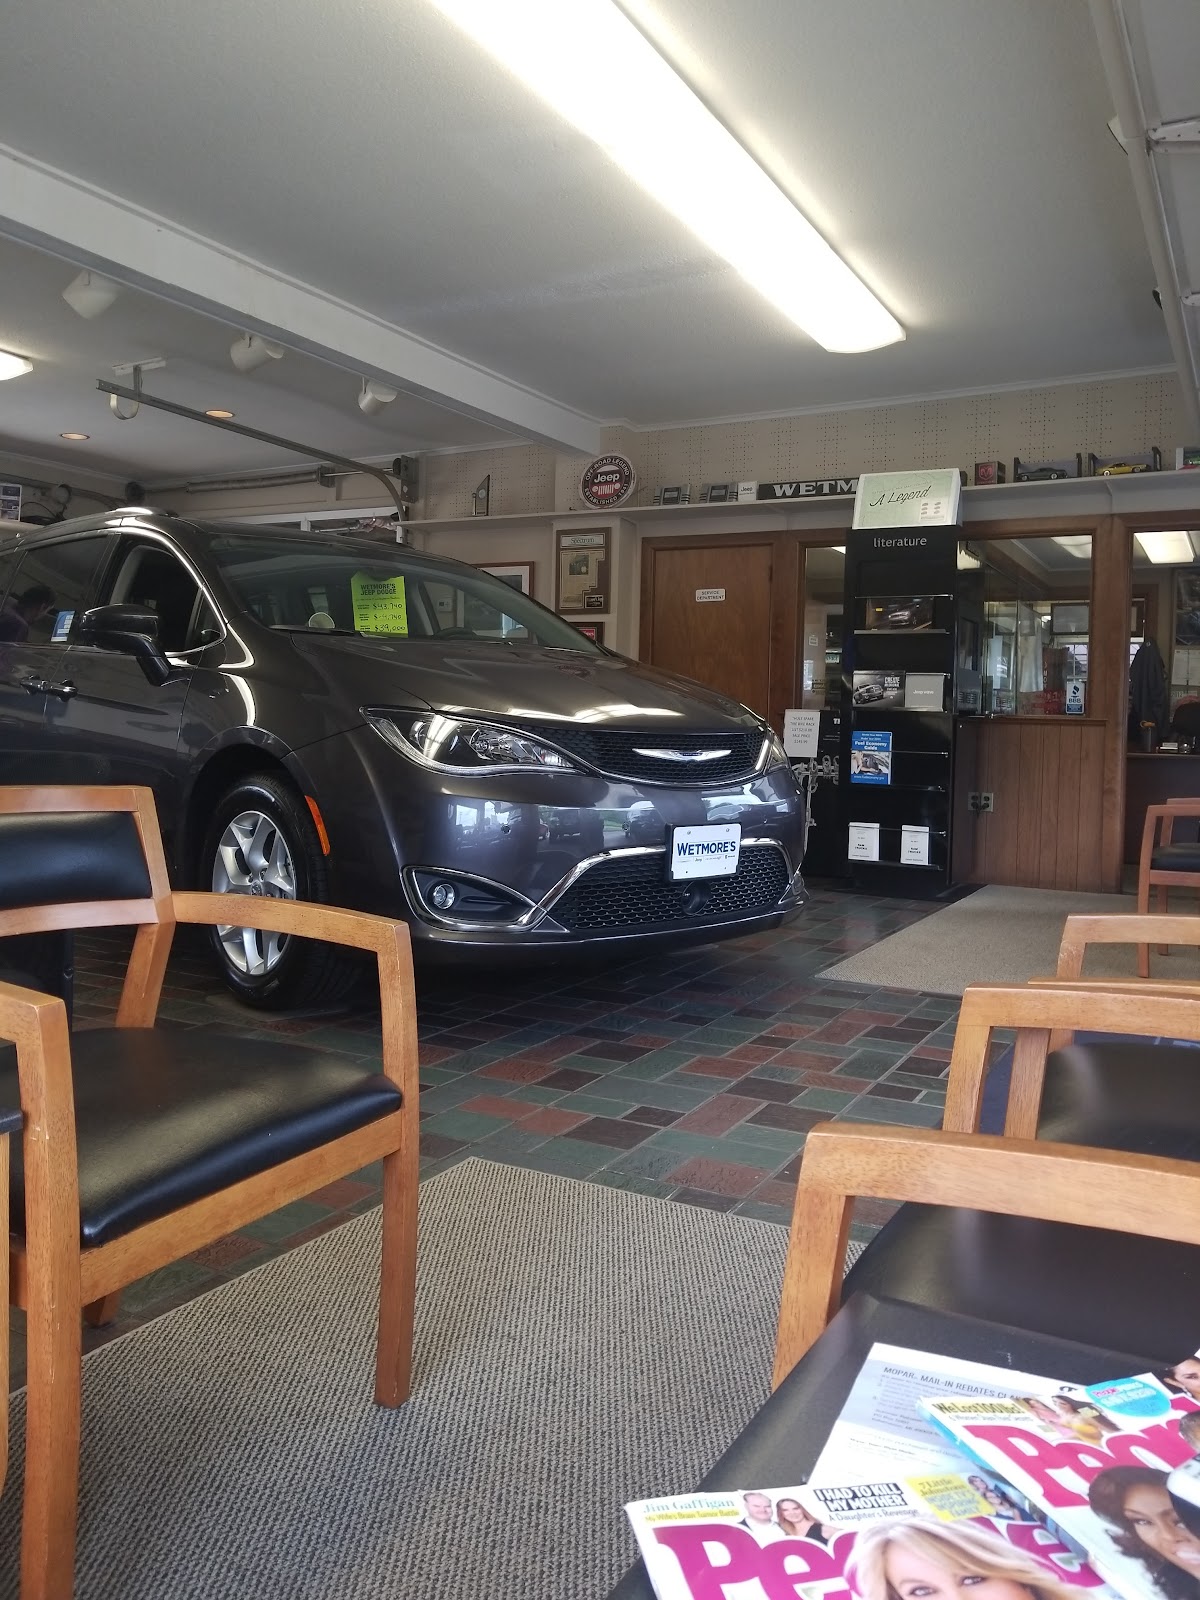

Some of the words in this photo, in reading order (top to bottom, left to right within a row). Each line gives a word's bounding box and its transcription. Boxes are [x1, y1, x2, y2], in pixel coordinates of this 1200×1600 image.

[612, 458, 630, 476] LEGEND
[594, 473, 620, 483] Jeep
[585, 488, 618, 505] ESTABLISHED
[869, 493, 886, 507] A
[887, 485, 931, 504] Legend
[873, 537, 928, 548] literature
[677, 841, 736, 856] WETMORE'S
[920, 1374, 954, 1388] MAIL-IN
[955, 1382, 995, 1397] REBATES
[822, 1488, 853, 1500] HAD
[850, 1485, 872, 1497] TO
[869, 1483, 902, 1496] KILL
[643, 1504, 670, 1513] Jim
[672, 1498, 735, 1511] Gaffigan
[825, 1499, 849, 1511] MY
[847, 1494, 905, 1510] MOTHER
[645, 1514, 656, 1522] My
[657, 1513, 678, 1521] Wife's
[677, 1511, 696, 1519] Brain
[697, 1510, 718, 1519] Tumor
[719, 1509, 740, 1517] Battle
[835, 1511, 882, 1522] Daughter's
[881, 1509, 919, 1518] Revenge
